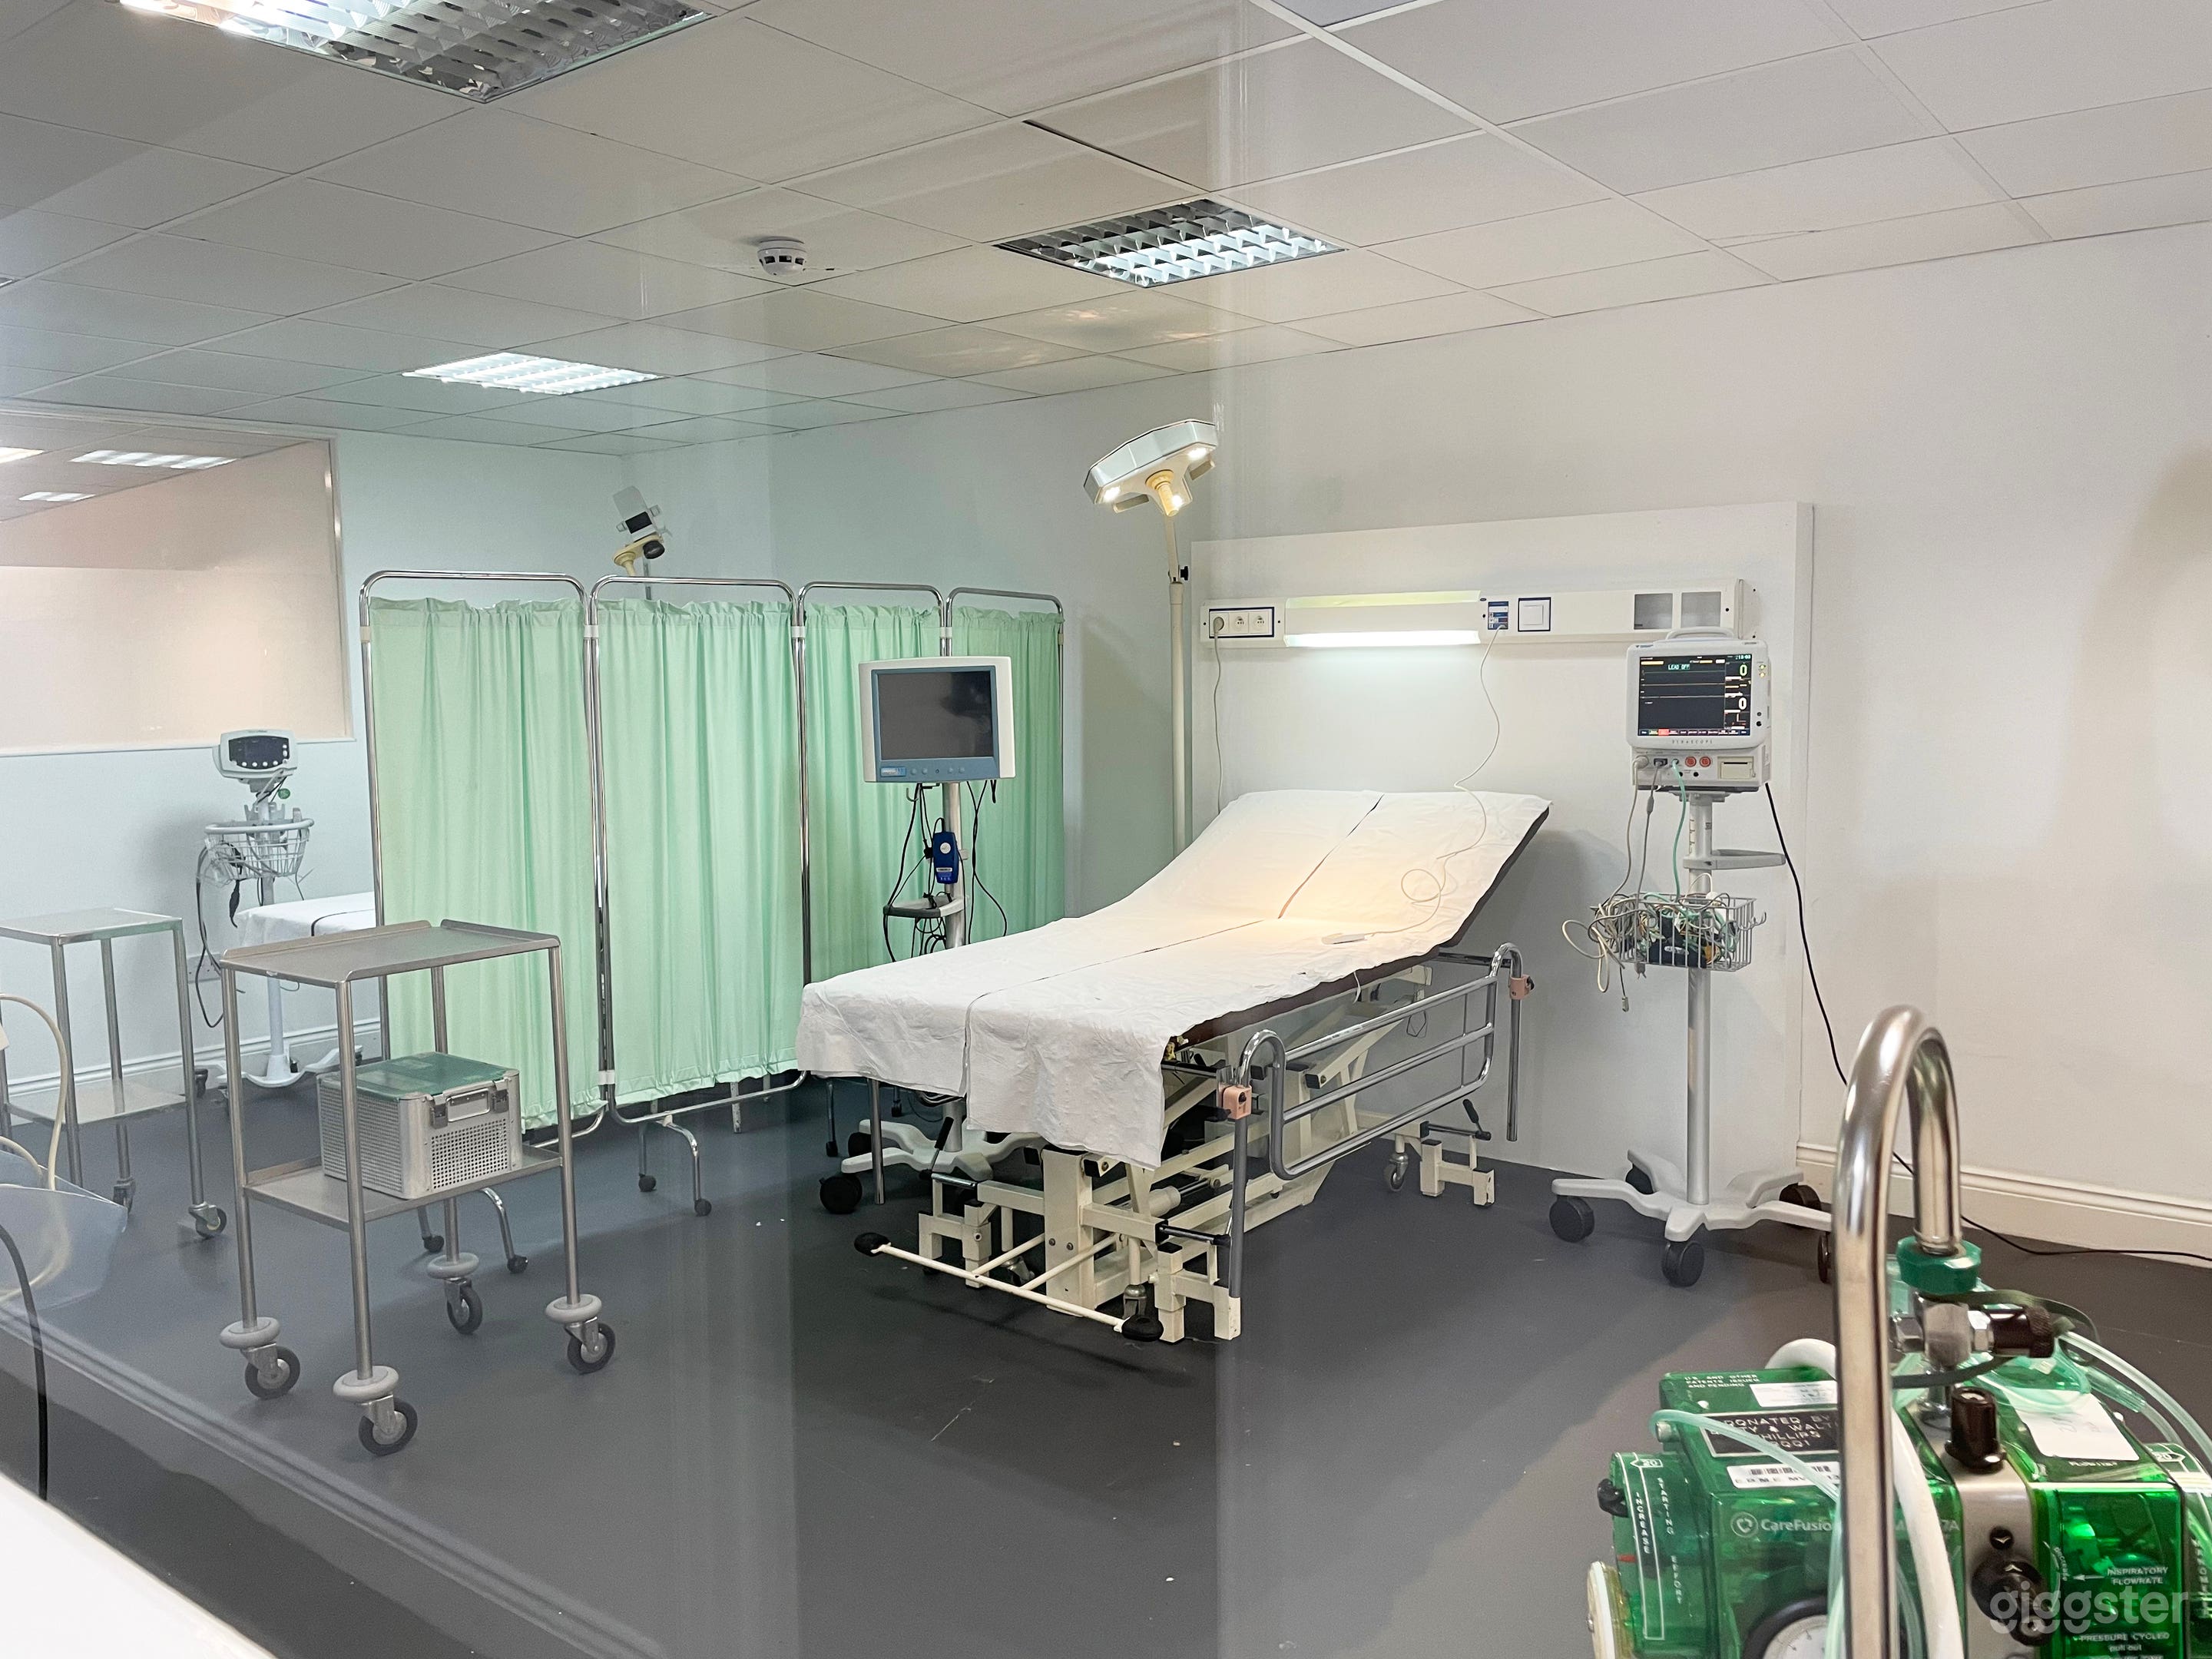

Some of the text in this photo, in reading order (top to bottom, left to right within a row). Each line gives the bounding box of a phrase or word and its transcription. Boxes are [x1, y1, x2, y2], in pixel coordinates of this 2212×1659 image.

[1740, 664, 1747, 676] 0
[1738, 697, 1747, 710] 0
[1789, 1422, 1838, 1432] WALT
[1761, 1431, 1821, 1440] HILLIPS
[1657, 1478, 1674, 1535] STARTING
[1636, 1492, 1650, 1554] INCREASE
[1761, 1519, 1833, 1532] CareFusio
[2108, 1567, 2168, 1576] INSPIRATORY
[2113, 1577, 2164, 1585] FLOWRATE
